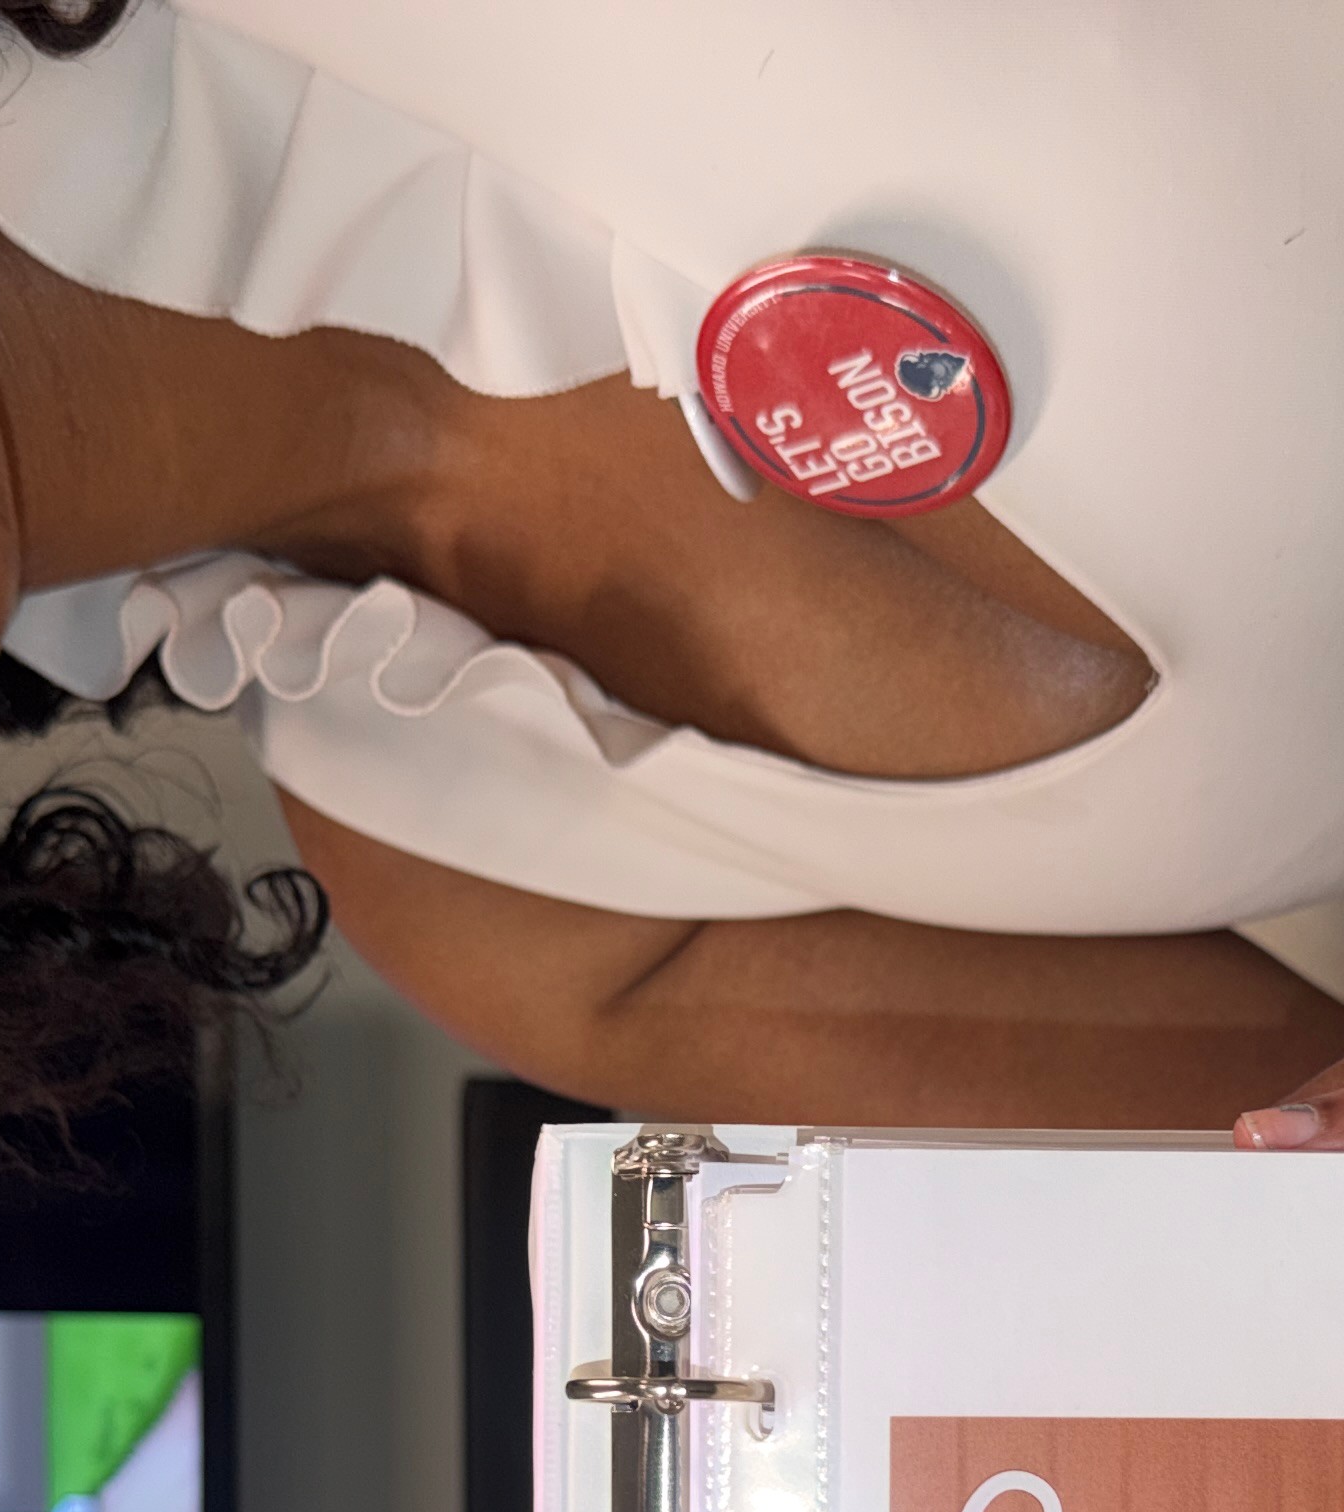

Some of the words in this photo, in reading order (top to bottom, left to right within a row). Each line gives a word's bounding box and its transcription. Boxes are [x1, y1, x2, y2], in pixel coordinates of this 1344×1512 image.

[711, 353, 734, 413] HOWARD
[827, 350, 942, 469] BISON
[755, 405, 851, 496] LET'S
[830, 432, 894, 483] GO
